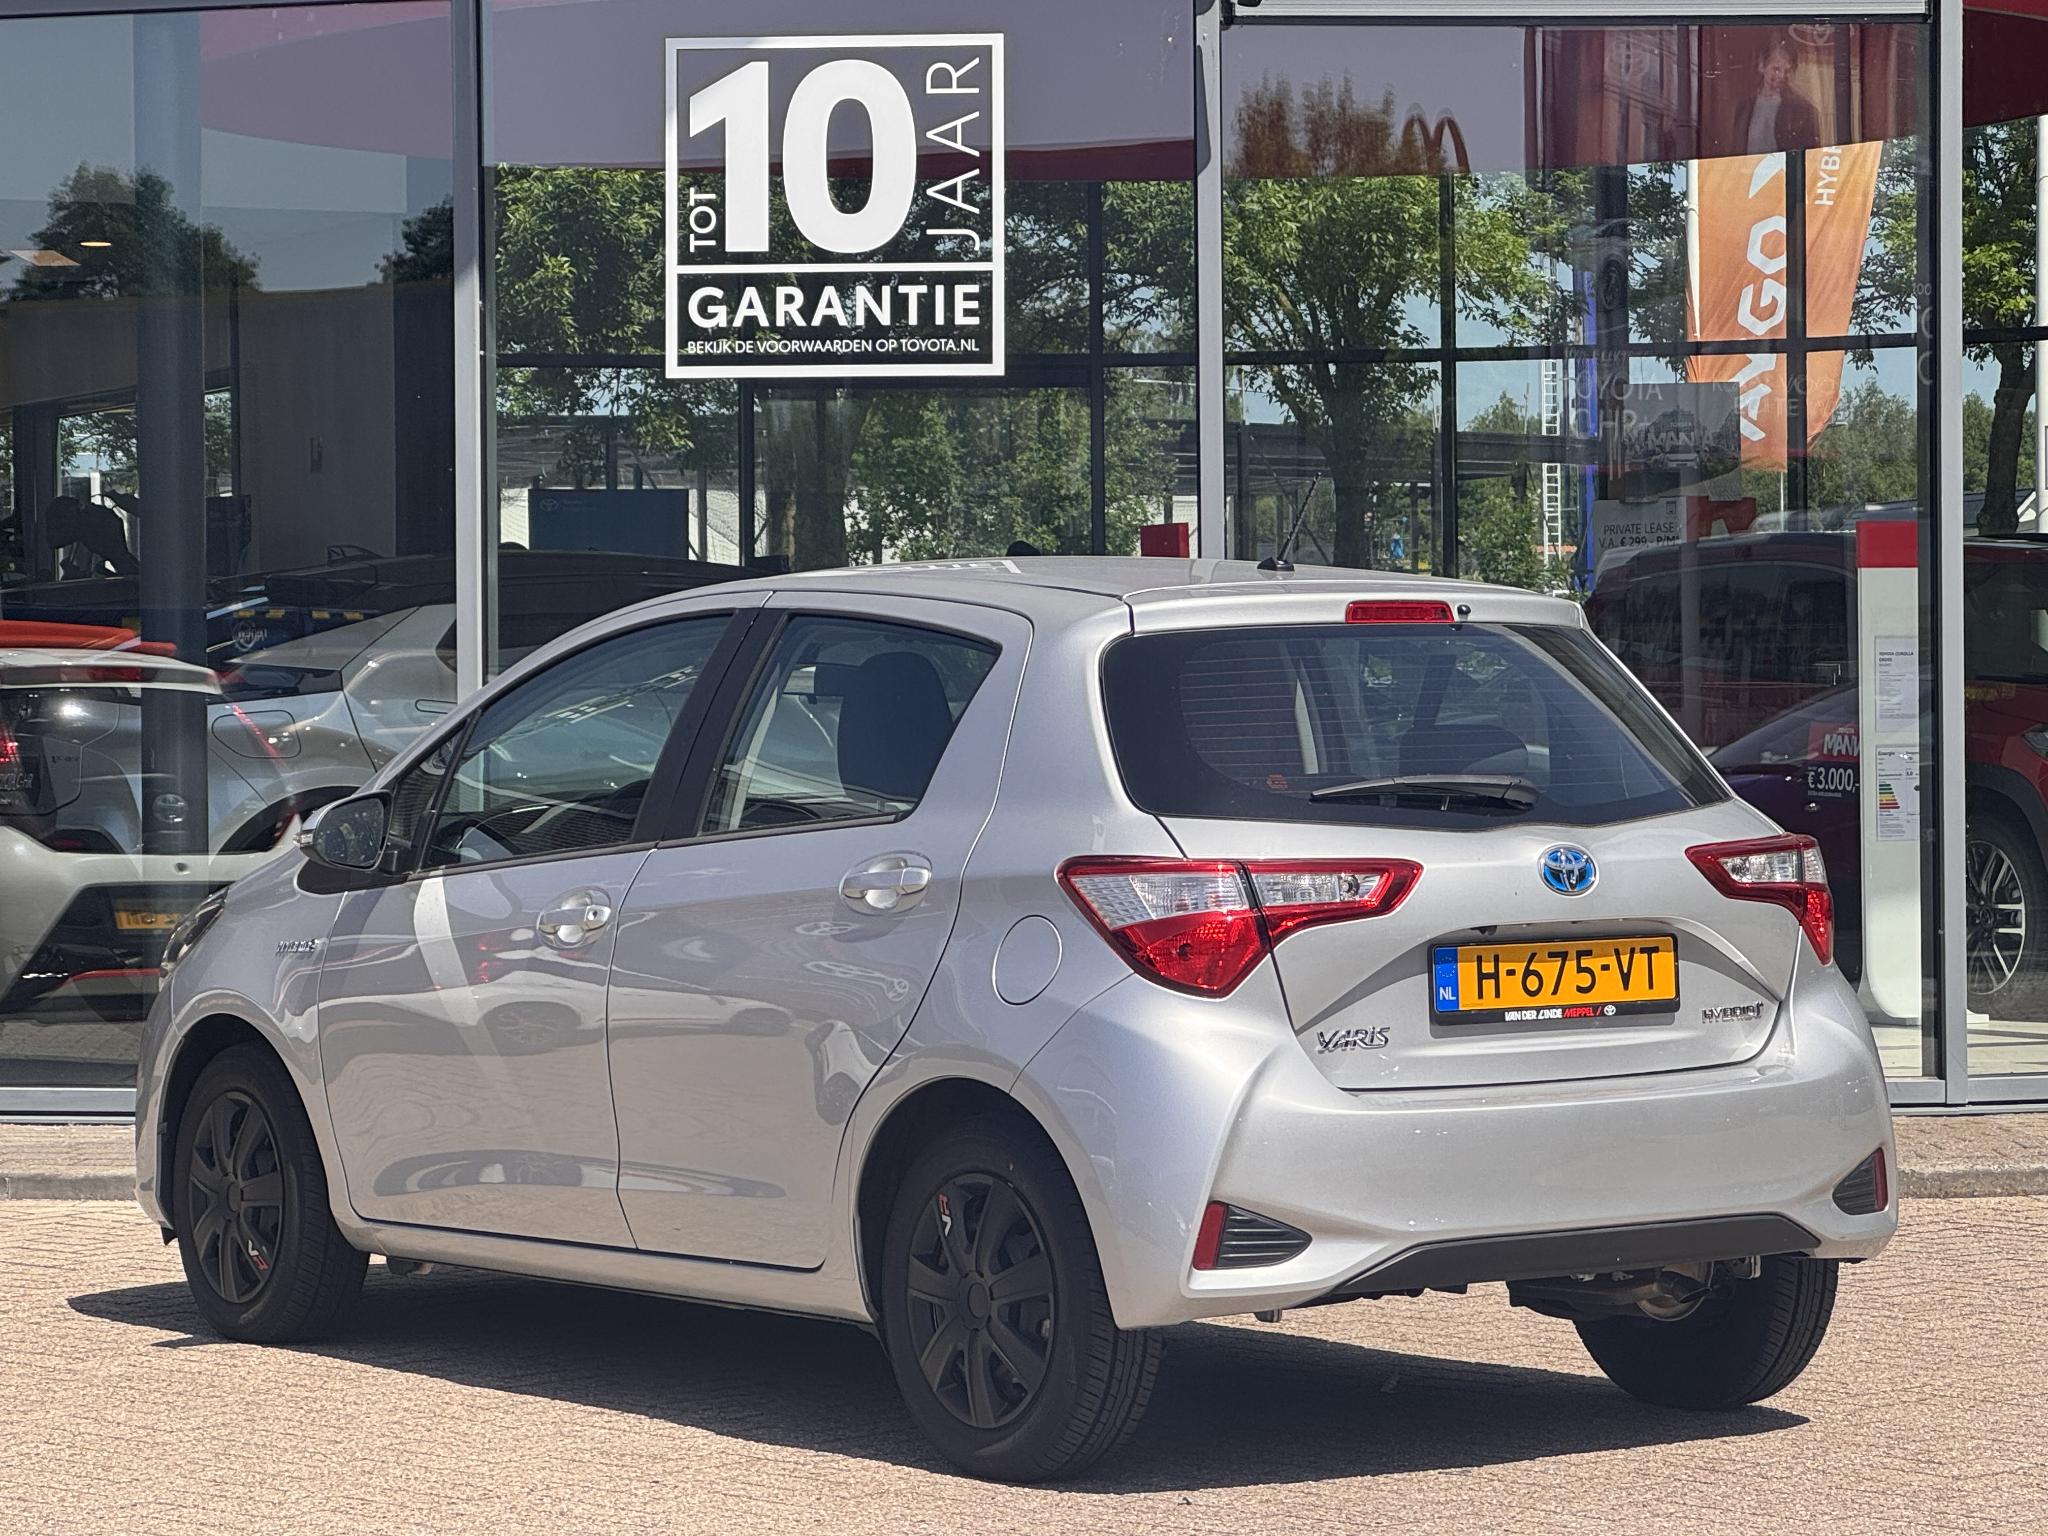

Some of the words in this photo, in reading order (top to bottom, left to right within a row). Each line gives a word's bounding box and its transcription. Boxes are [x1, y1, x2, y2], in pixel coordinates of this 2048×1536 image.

[690, 59, 917, 254] 10
[926, 57, 980, 251] JAAR
[689, 187, 717, 253] TOT
[688, 285, 980, 329] GARANTIE
[687, 340, 733, 354] BEKIJK
[735, 340, 754, 353] DE
[757, 339, 873, 353] VOORWAARDEN
[875, 339, 898, 352] OP
[899, 338, 980, 352] TOYOTA.NL
[1603, 523, 1641, 535] PRIVATE
[1644, 522, 1674, 534] LEASE
[1439, 986, 1457, 1001] NL
[1476, 946, 1660, 1000] H-675-VT
[1504, 1011, 1521, 1022] VAN
[1521, 1010, 1537, 1021] DER
[1538, 1008, 1563, 1020] LINDE
[1563, 1007, 1595, 1018] MEPPEL
